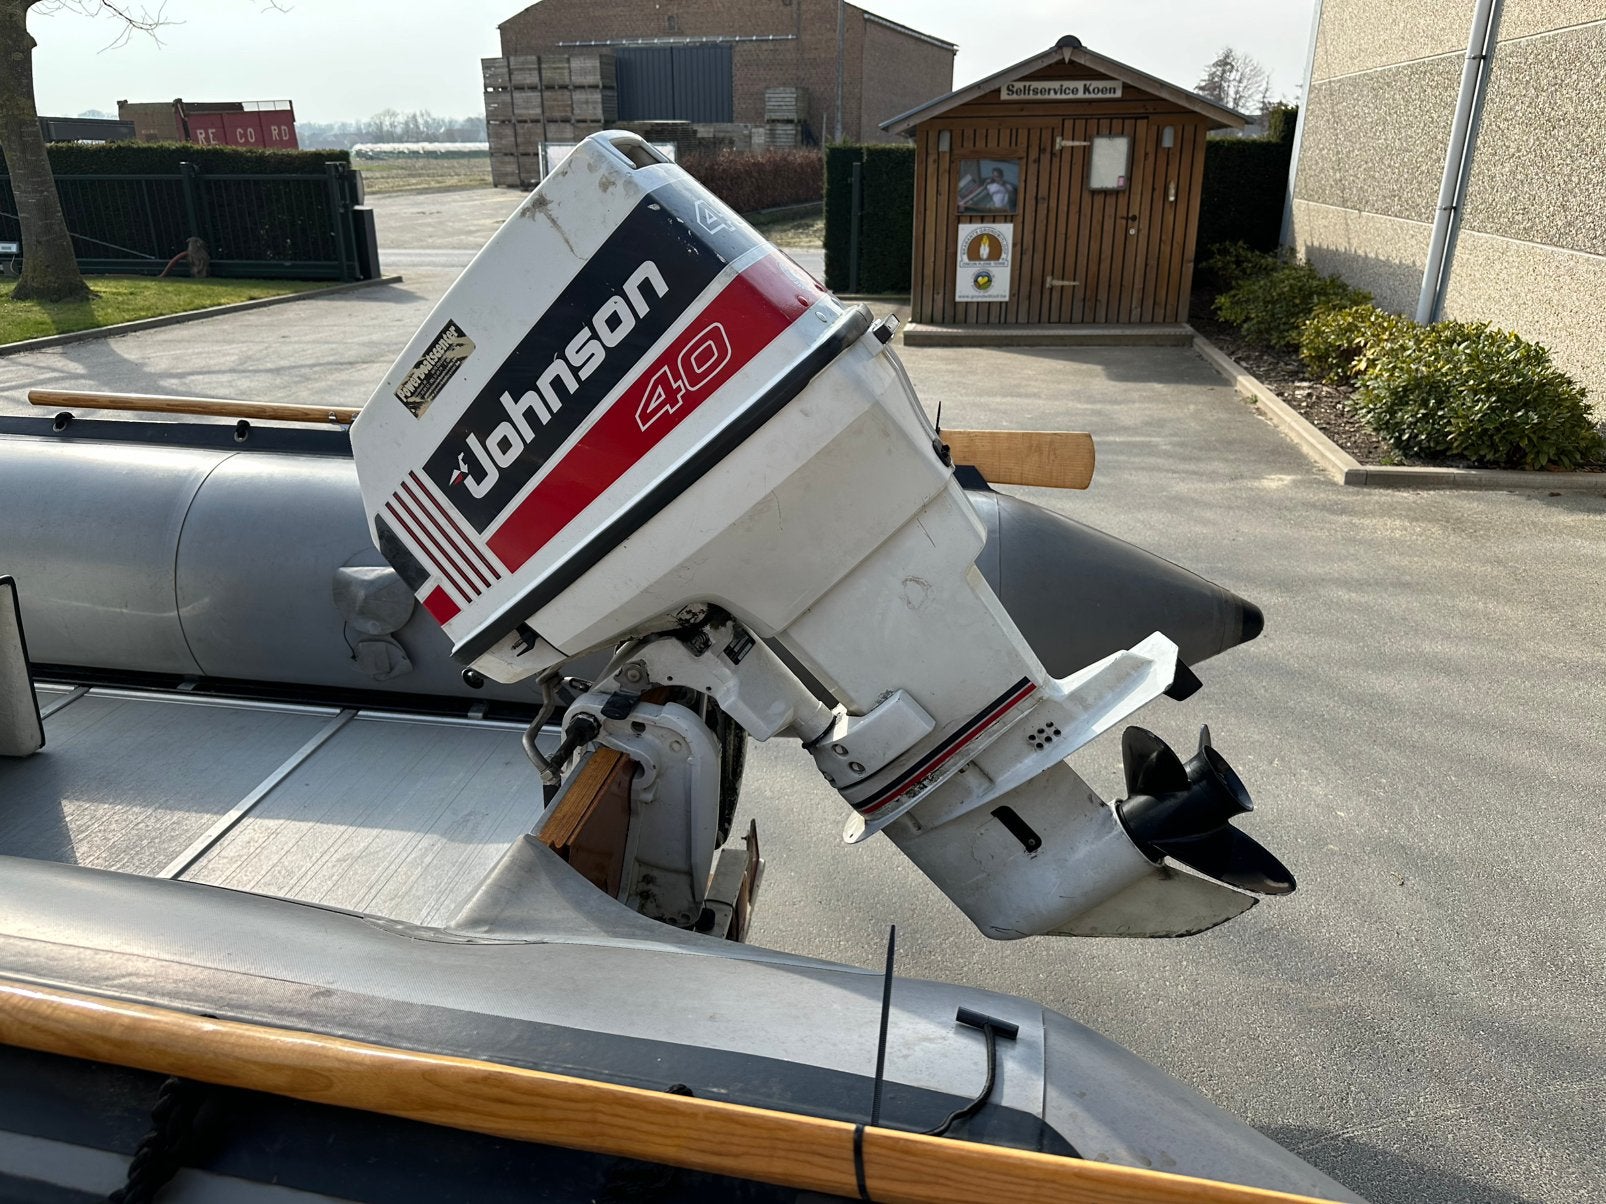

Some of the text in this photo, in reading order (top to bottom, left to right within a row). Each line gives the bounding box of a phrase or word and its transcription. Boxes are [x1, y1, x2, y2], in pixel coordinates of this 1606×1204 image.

[1006, 83, 1116, 96] Selfservice Koen
[463, 260, 669, 499] Johnson
[635, 322, 732, 432] 40
